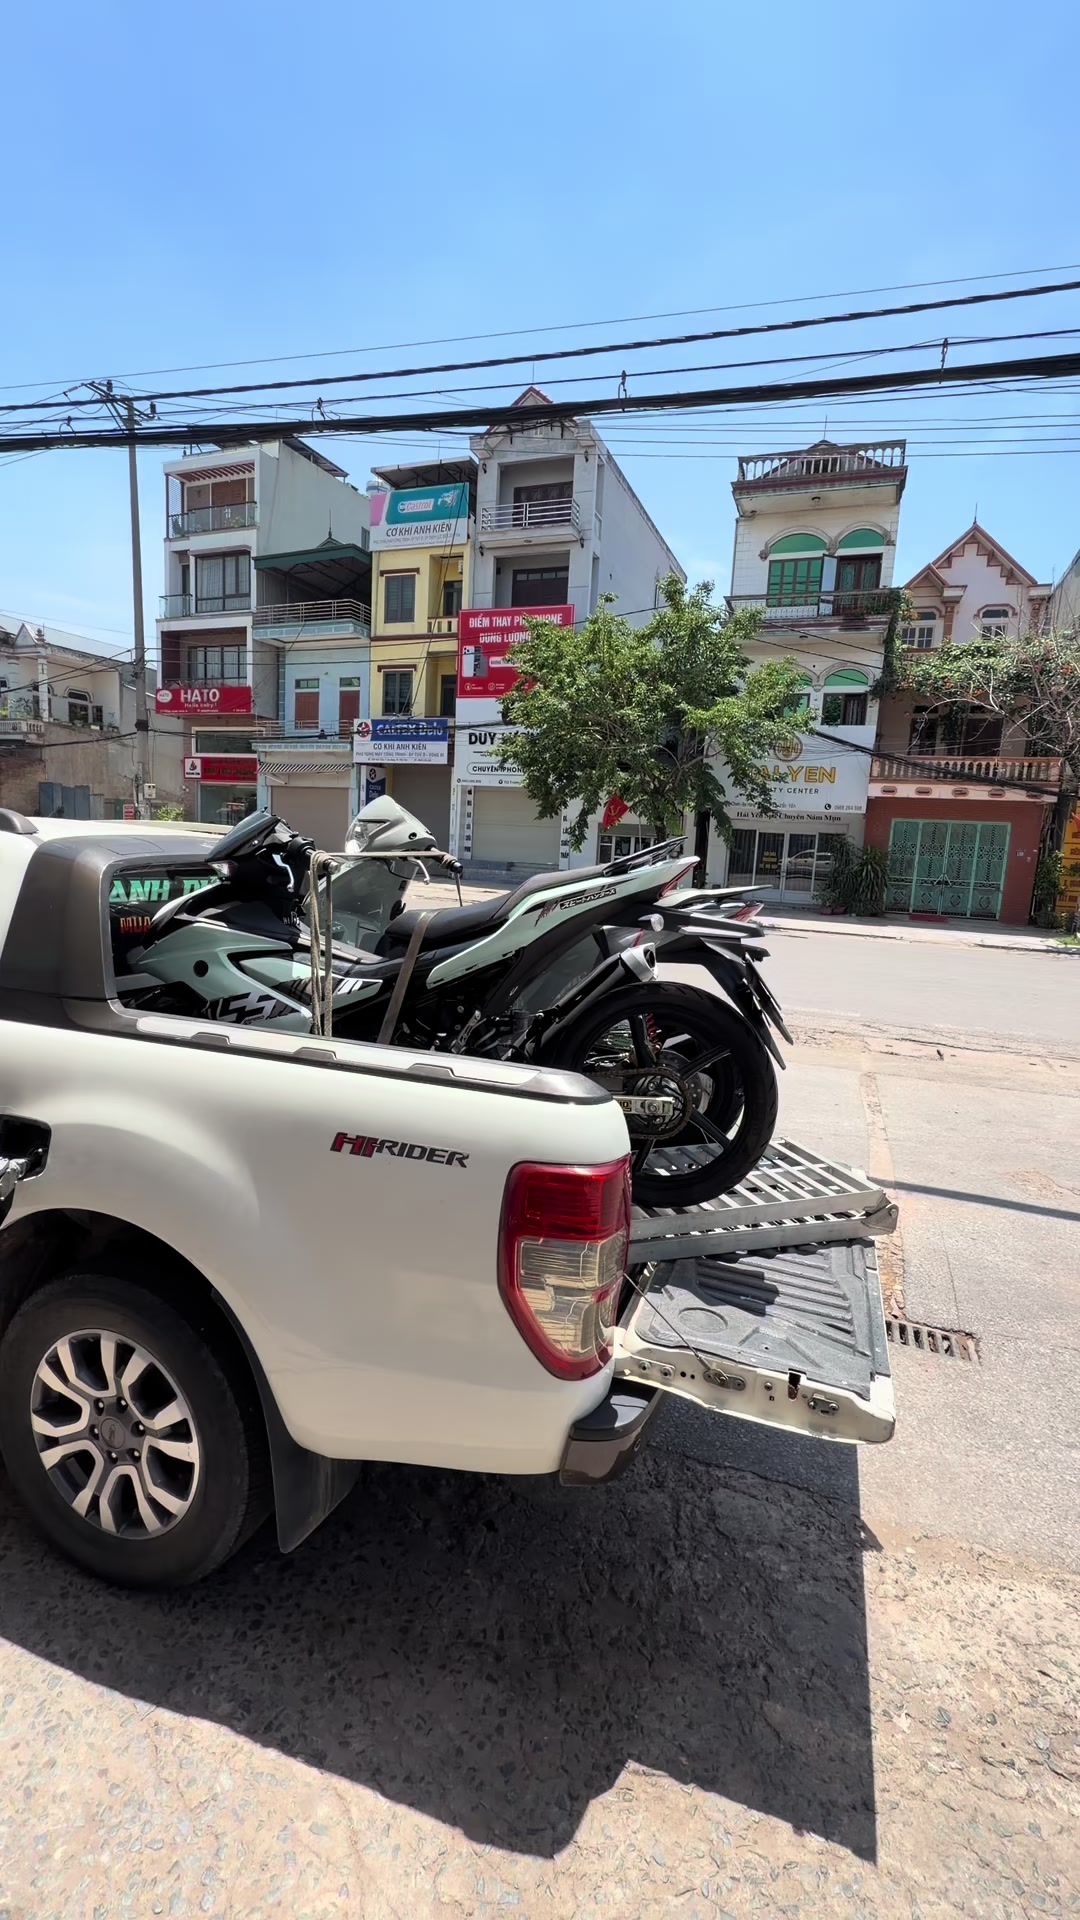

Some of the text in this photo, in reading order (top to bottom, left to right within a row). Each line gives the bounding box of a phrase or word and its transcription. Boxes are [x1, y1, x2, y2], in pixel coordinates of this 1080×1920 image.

[406, 502, 432, 511] Castrol
[414, 526, 431, 535] ANH
[469, 614, 490, 628] ĐIỂM
[492, 616, 512, 627] THAY
[180, 688, 220, 703] HATO
[468, 733, 496, 745] DUY
[787, 766, 836, 783] YEN
[109, 879, 170, 903] ANH
